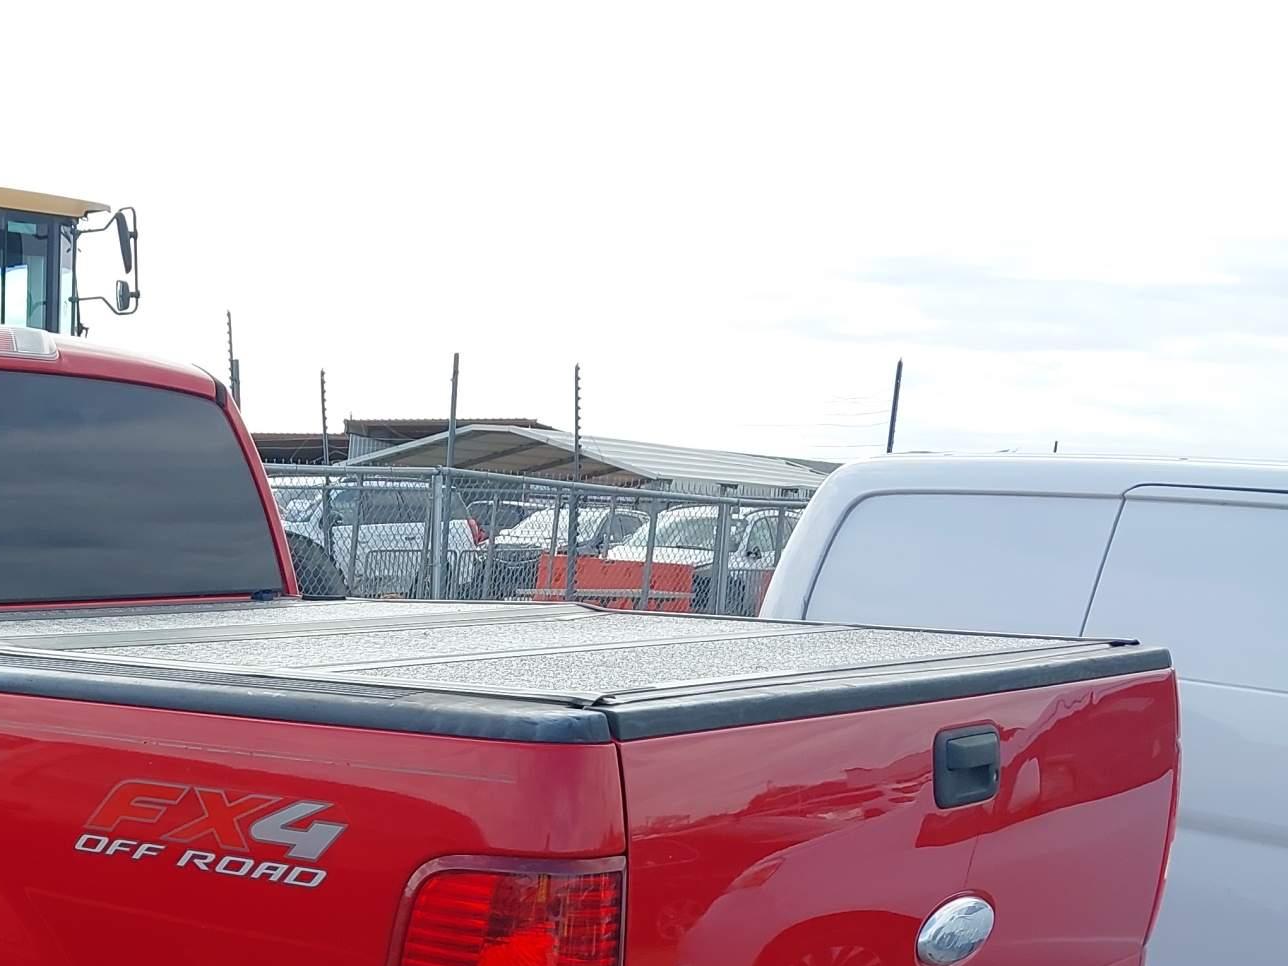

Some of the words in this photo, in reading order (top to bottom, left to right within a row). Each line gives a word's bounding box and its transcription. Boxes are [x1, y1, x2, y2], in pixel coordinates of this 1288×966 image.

[83, 778, 349, 863] FX4
[74, 833, 166, 861] OFF
[176, 848, 328, 888] ROAD
